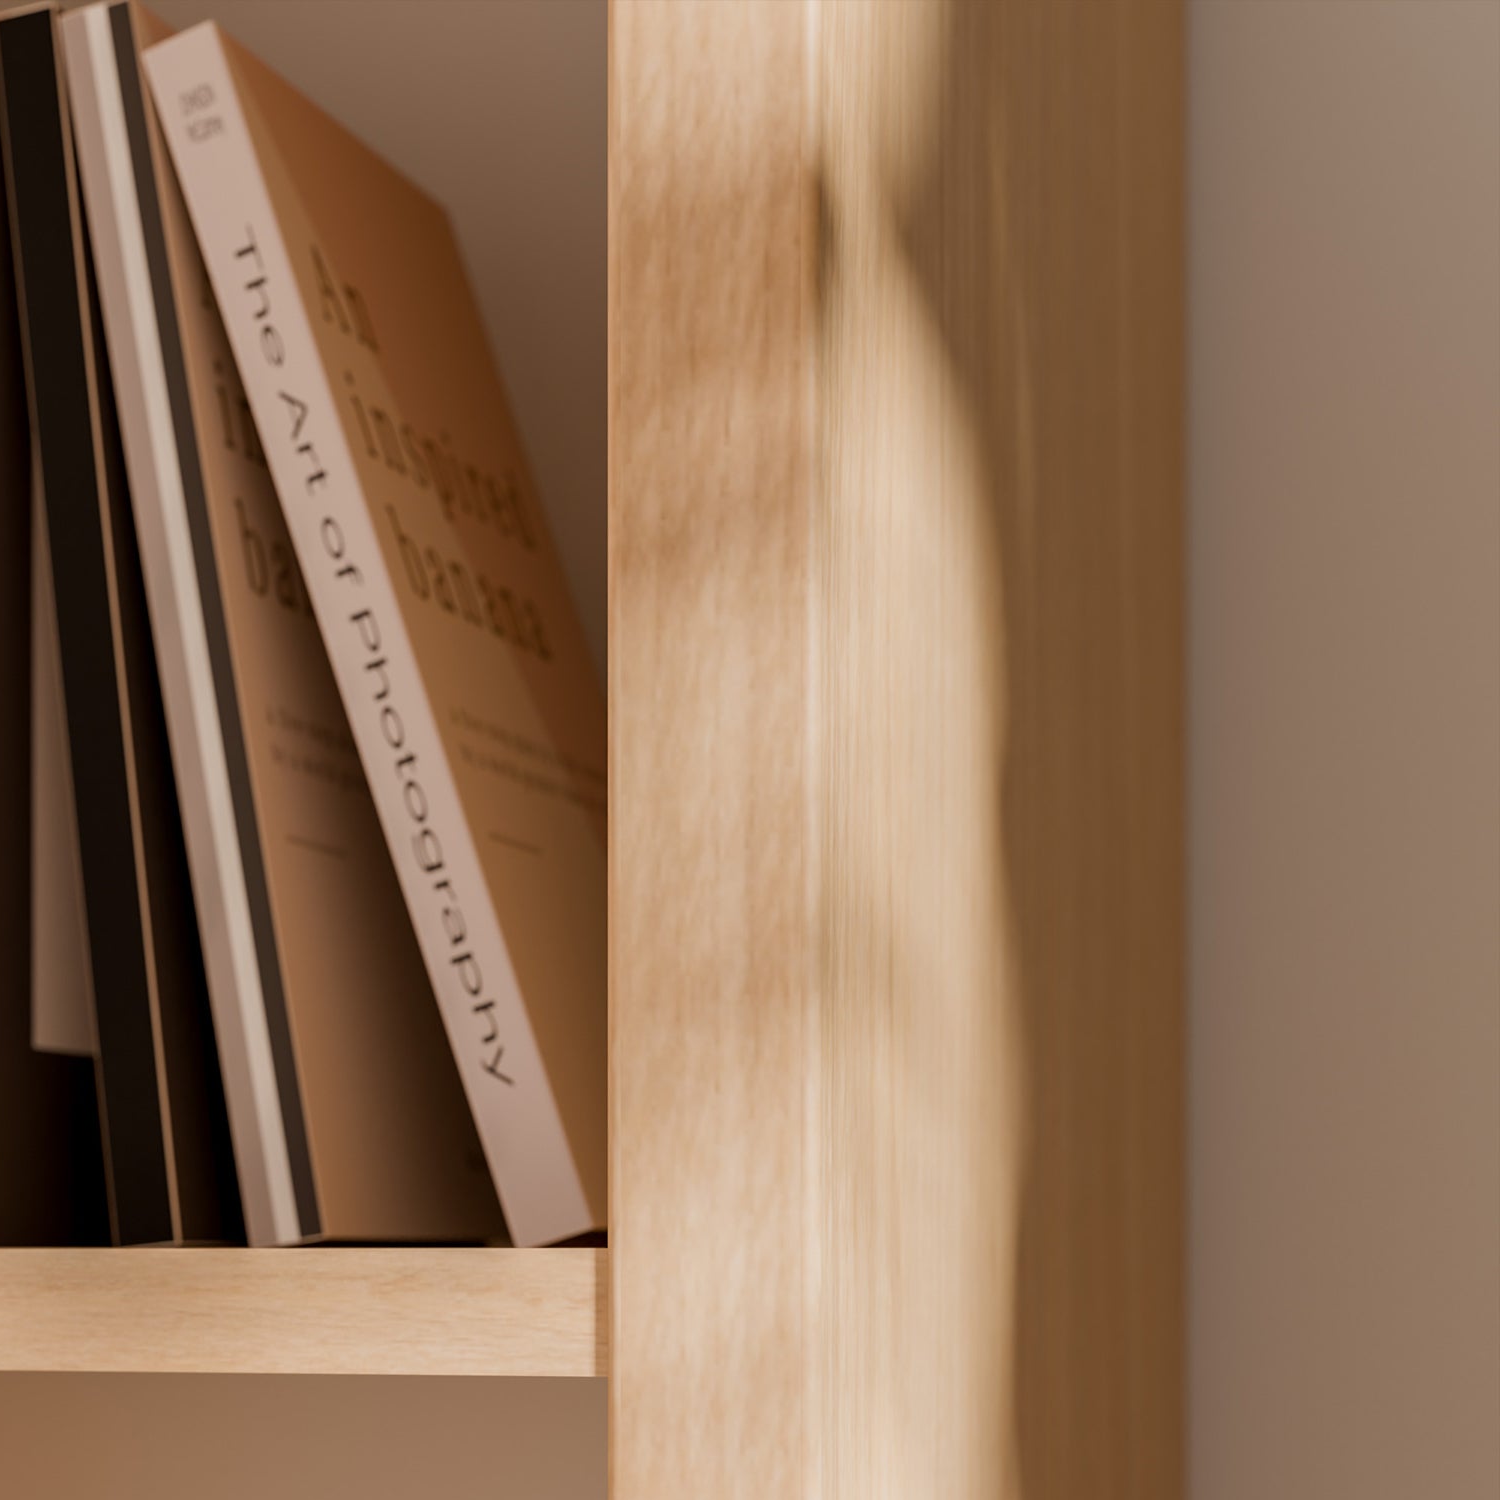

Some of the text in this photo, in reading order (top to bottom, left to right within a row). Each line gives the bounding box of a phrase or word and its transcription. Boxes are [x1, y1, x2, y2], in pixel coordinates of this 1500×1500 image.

[232, 220, 287, 370] The
[278, 388, 330, 498] Art
[318, 514, 365, 590] of
[347, 605, 517, 1090] Photography
